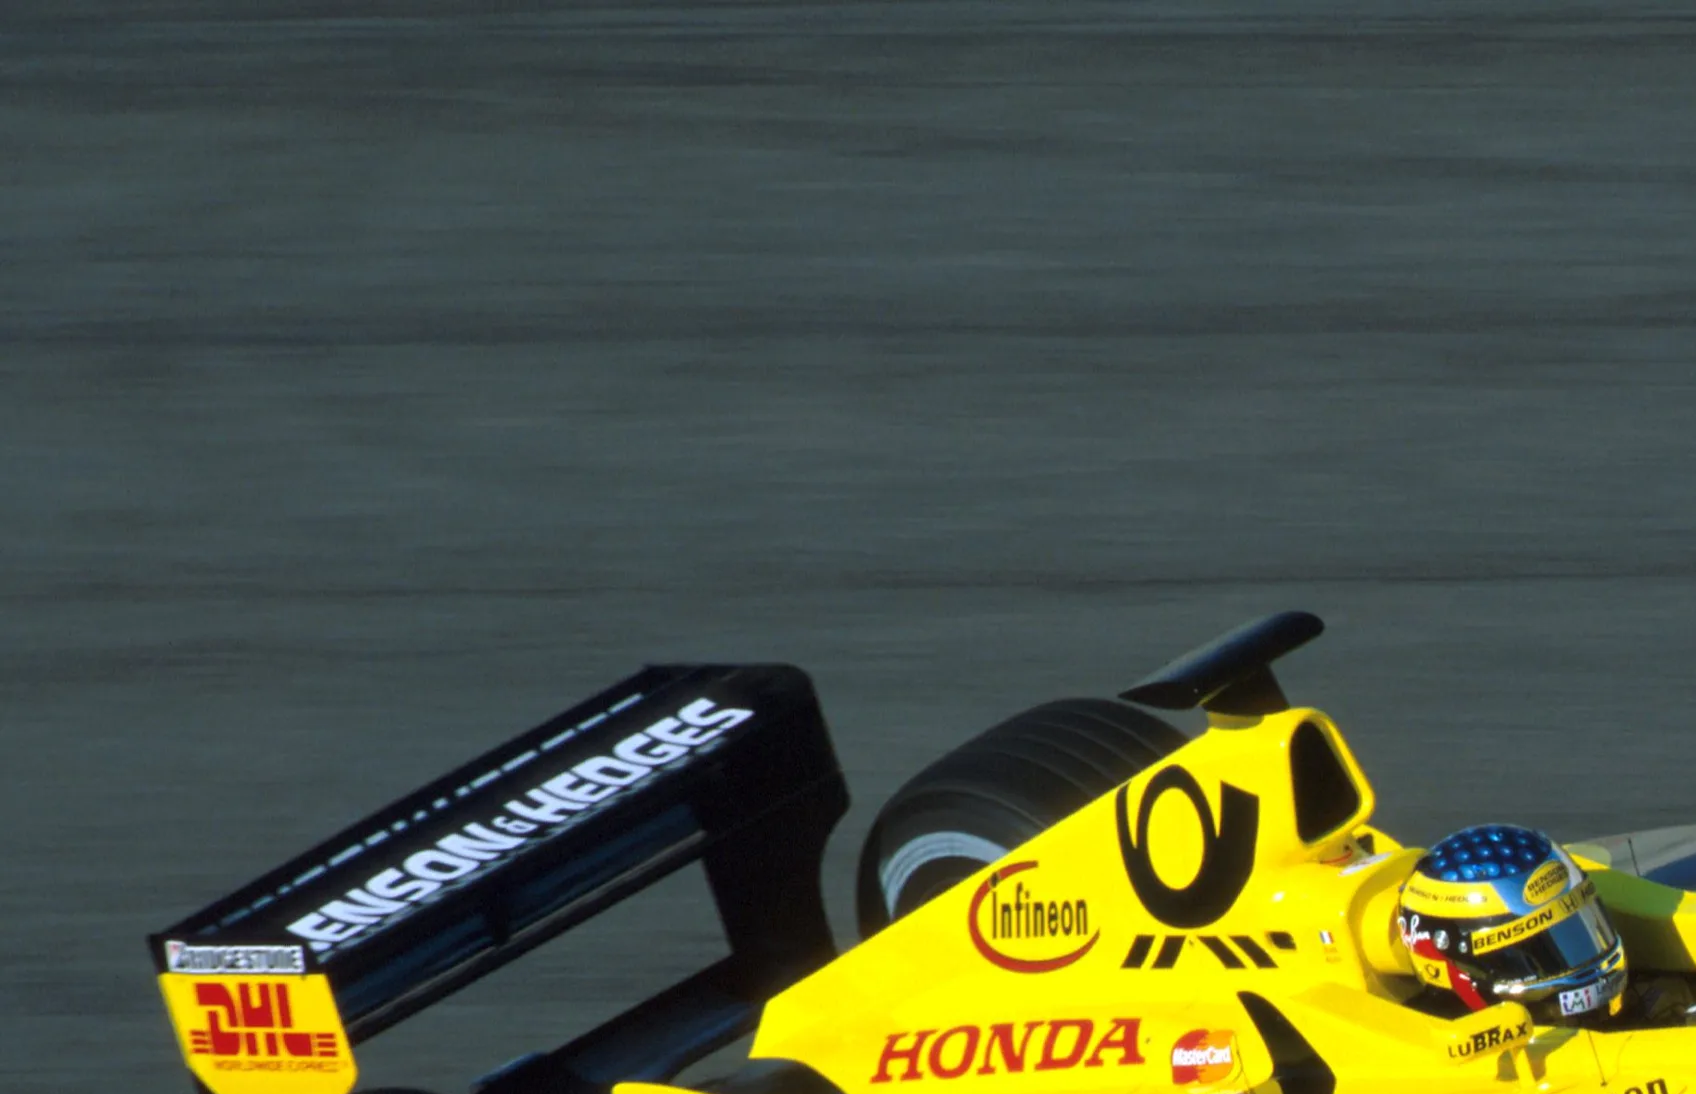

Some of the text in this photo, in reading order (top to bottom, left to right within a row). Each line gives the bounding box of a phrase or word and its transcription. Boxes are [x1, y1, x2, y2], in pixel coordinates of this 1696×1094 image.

[285, 822, 527, 953] ENSON
[503, 697, 754, 823] HEDGES
[988, 872, 1088, 941] Infineon
[1474, 908, 1553, 949] BENSON
[193, 982, 317, 1057] DHL
[870, 1018, 1145, 1083] HONDA
[1447, 1022, 1527, 1058] LUBRAX
